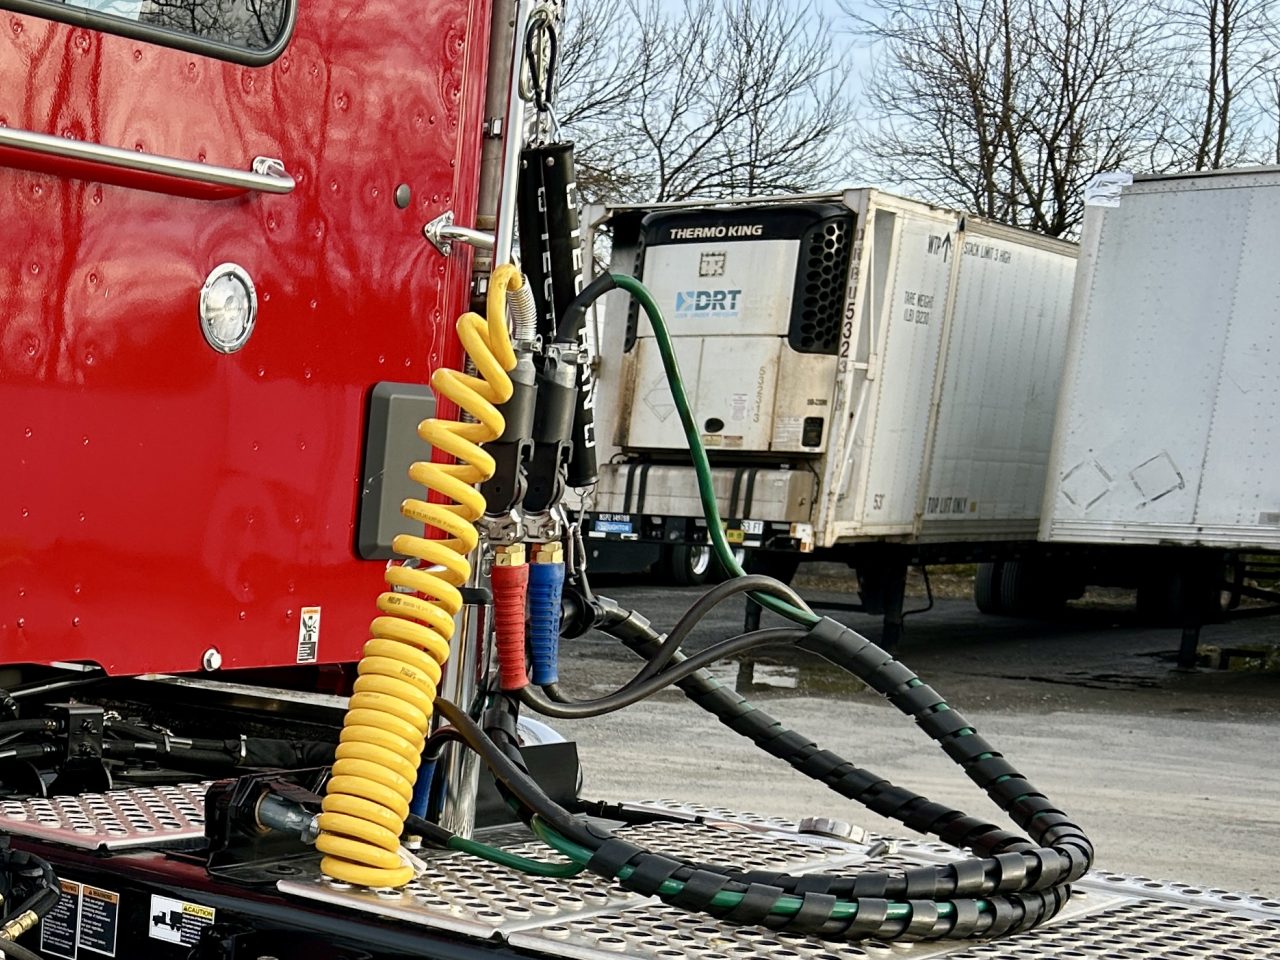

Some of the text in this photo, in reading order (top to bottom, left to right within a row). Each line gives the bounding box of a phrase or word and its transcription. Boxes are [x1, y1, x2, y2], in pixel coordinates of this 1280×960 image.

[670, 225, 763, 239] THERMO KING
[695, 290, 742, 311] DRT
[752, 522, 762, 532] FT
[188, 906, 213, 918] CAUTION
